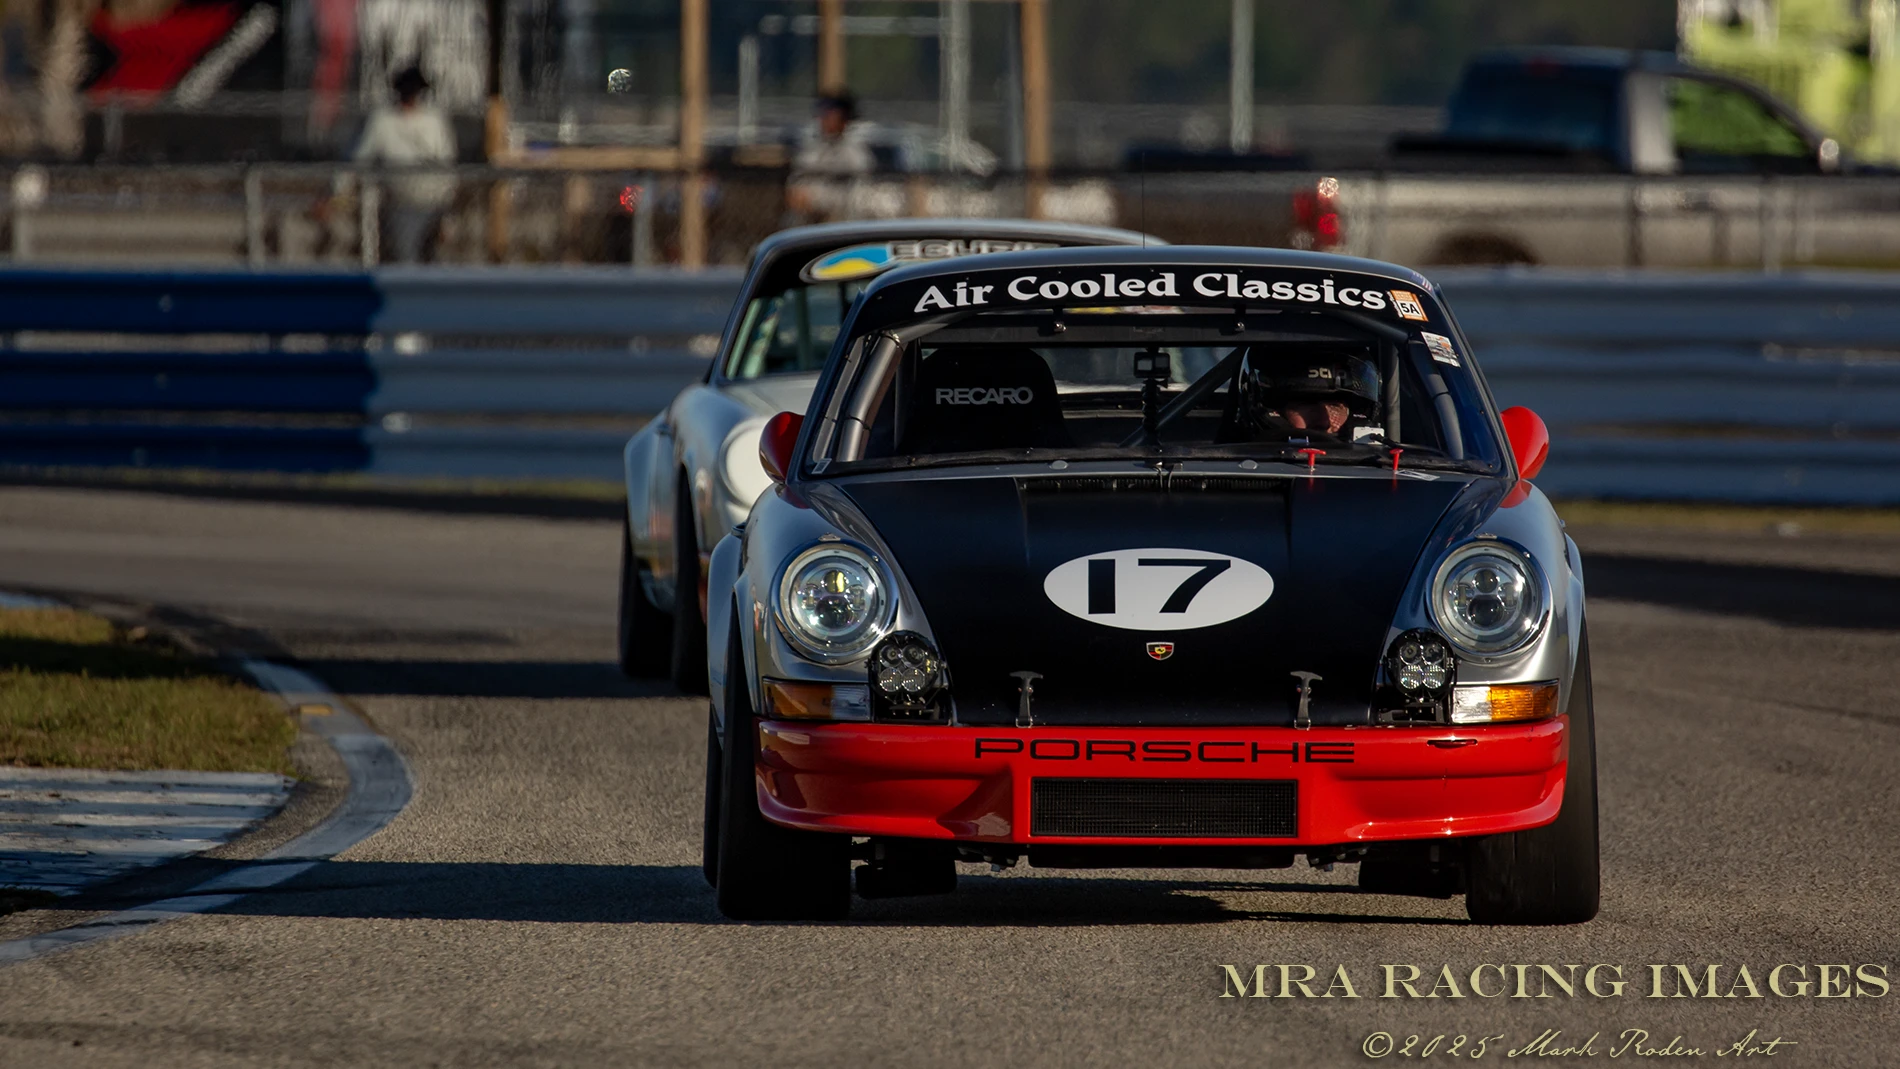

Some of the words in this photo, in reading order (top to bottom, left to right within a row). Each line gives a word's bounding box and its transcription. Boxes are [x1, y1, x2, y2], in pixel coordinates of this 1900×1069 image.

[913, 281, 994, 313] Air
[1007, 272, 1181, 301] Cooled
[1193, 272, 1387, 310] Classics
[1400, 303, 1420, 315] 5A
[935, 386, 1033, 405] RECARO
[1088, 558, 1231, 615] 17
[974, 738, 1355, 763] PORSCHE
